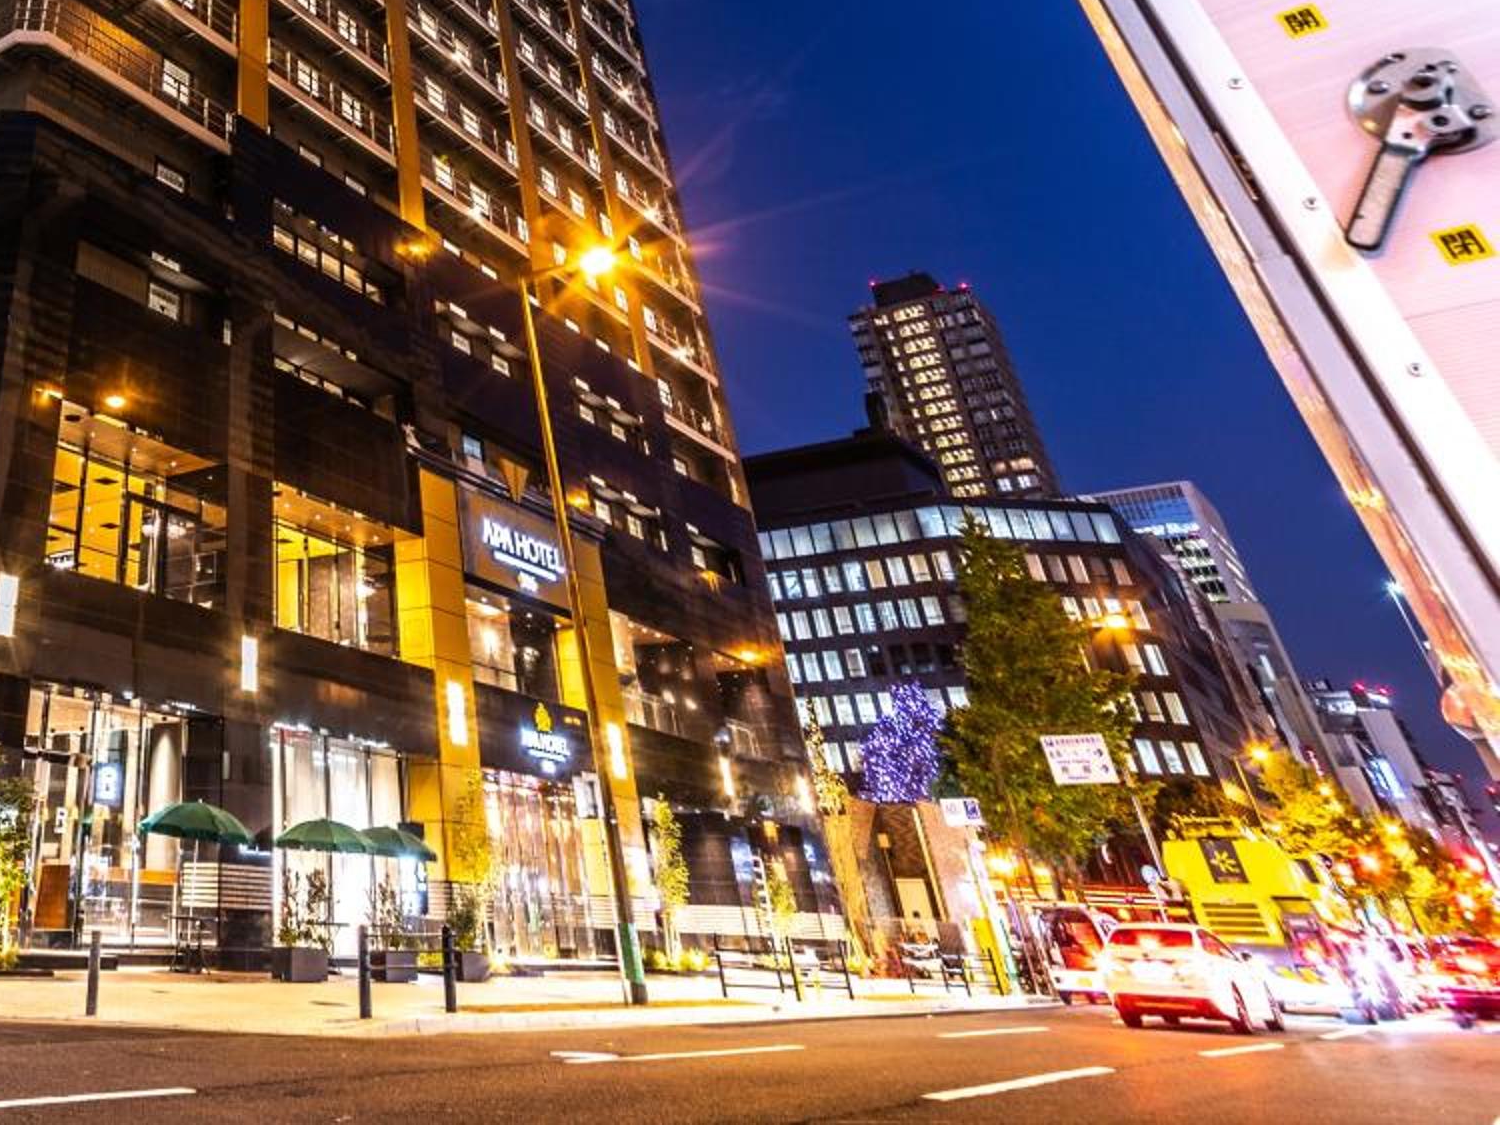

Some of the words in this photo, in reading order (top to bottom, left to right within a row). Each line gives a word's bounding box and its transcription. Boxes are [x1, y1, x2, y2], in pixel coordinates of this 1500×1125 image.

[1440, 228, 1485, 259] 閉
[483, 517, 514, 555] APA
[514, 531, 566, 574] HOTEL
